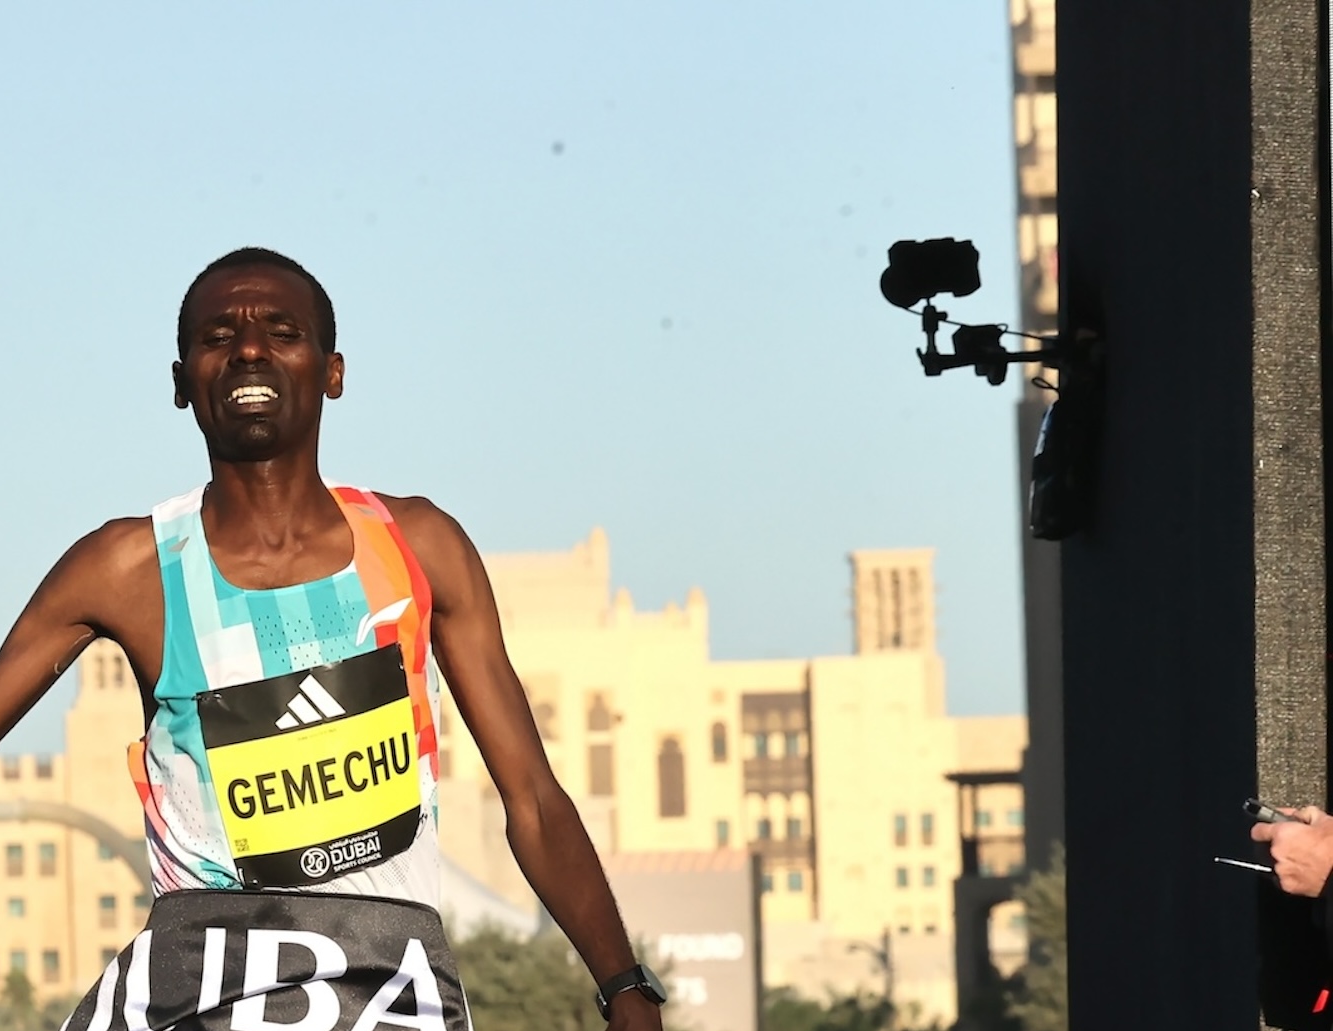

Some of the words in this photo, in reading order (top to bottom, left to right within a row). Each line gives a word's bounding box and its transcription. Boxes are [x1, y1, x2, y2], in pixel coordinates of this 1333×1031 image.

[228, 733, 410, 819] GEMECHU
[330, 836, 382, 866] DUBAI
[333, 860, 358, 873] SPORTS
